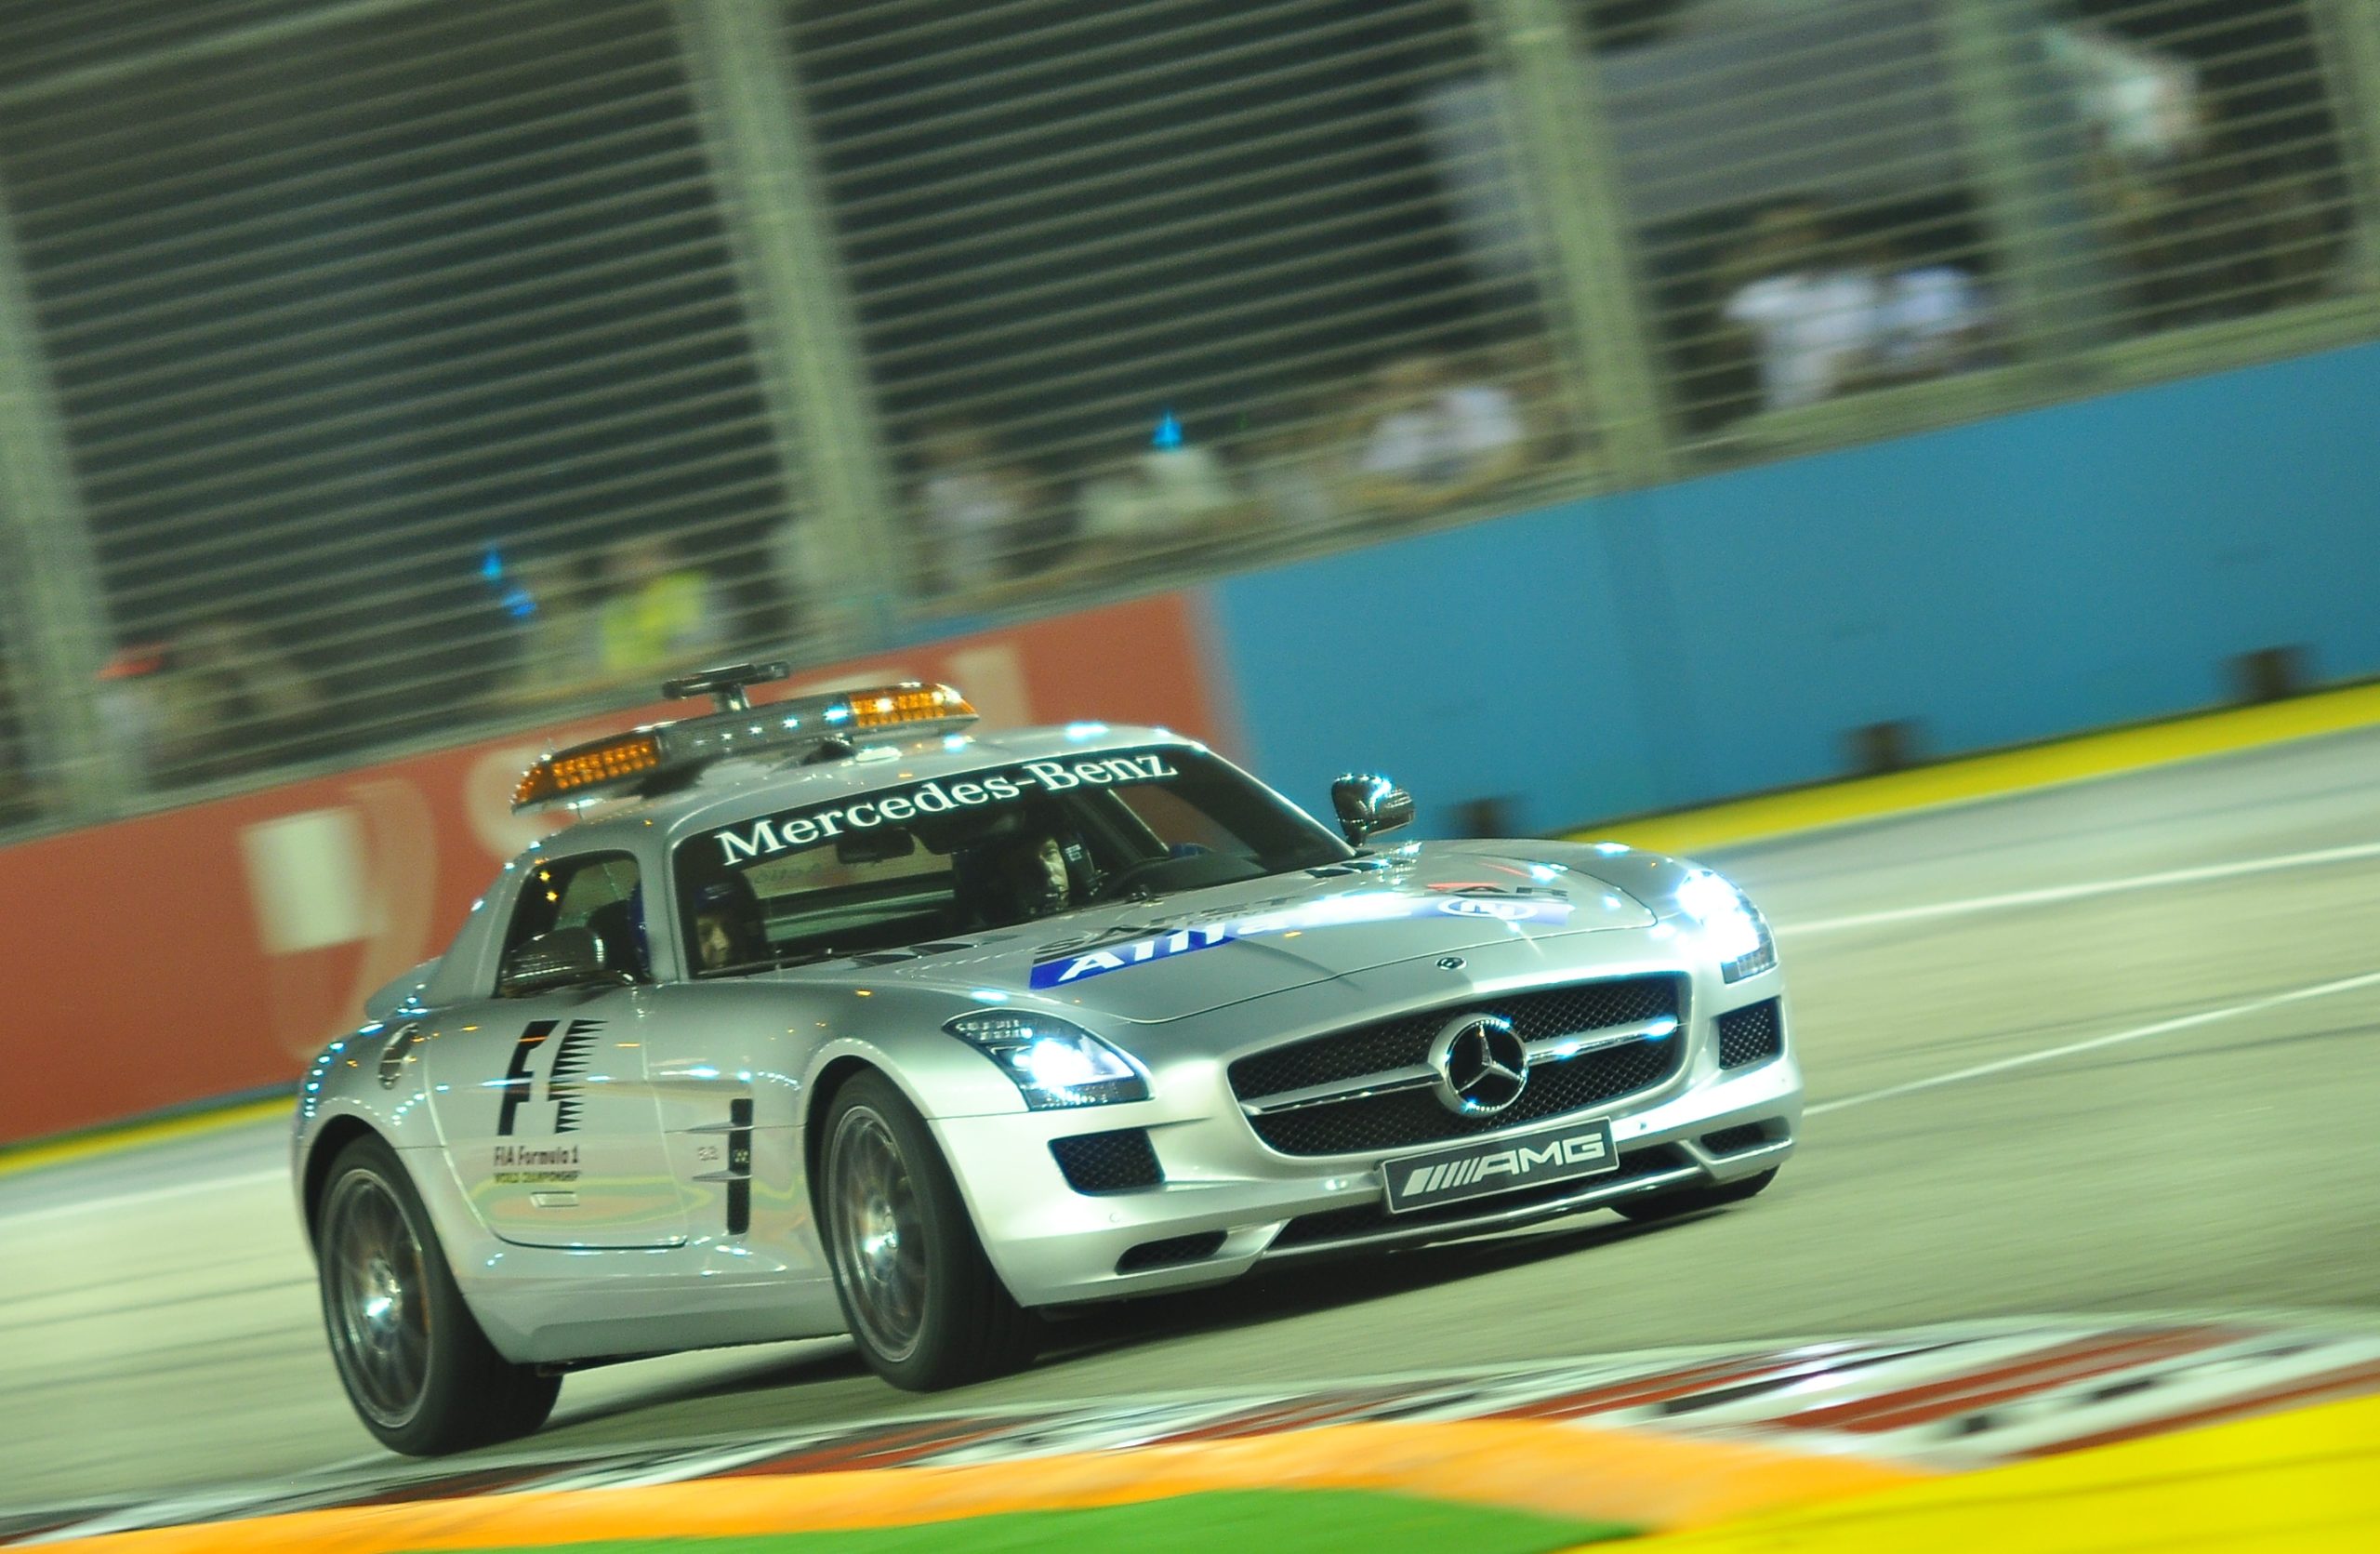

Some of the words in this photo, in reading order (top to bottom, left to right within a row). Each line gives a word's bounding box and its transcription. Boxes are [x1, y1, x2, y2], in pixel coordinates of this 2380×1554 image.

[713, 754, 1179, 867] Mercedes-Benz
[496, 1018, 610, 1136] F1
[518, 1145, 570, 1165] Formula
[1471, 1132, 1606, 1183] AMG
